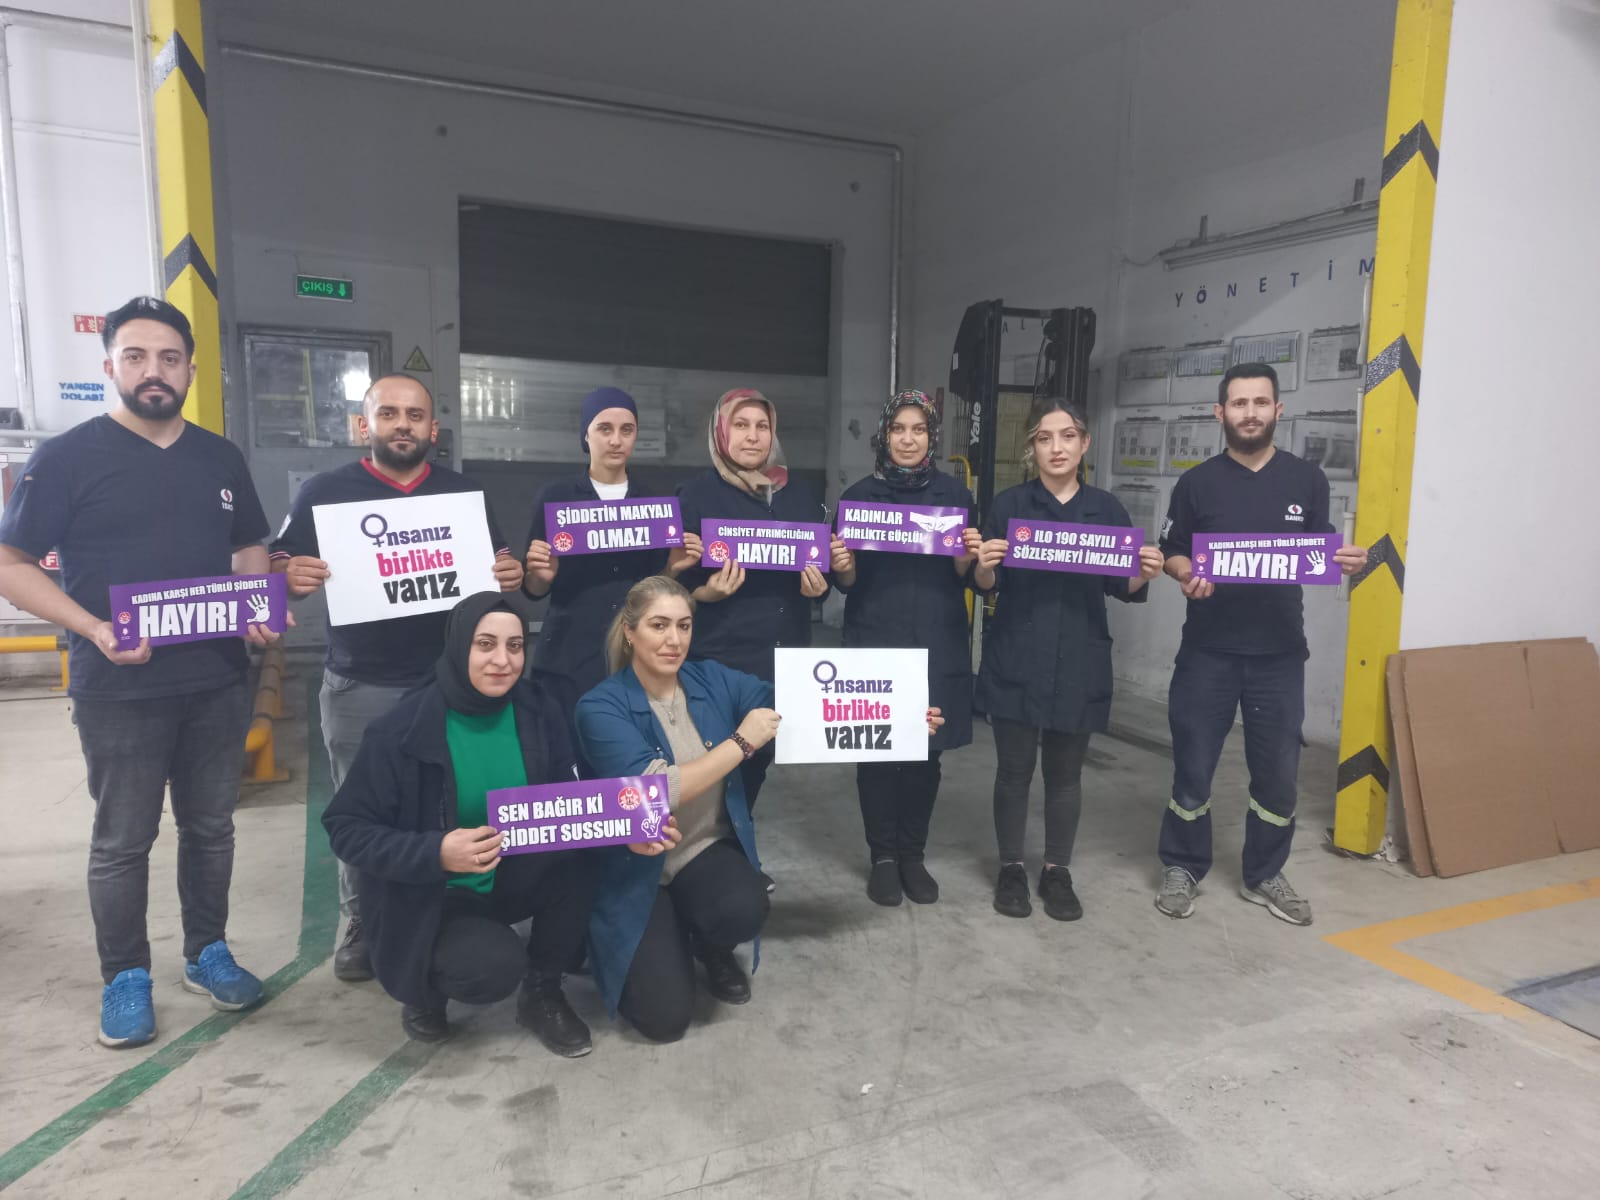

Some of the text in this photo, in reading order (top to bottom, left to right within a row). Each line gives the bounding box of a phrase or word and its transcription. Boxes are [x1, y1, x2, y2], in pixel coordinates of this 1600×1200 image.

[302, 281, 334, 294] ÇIKIŞ
[1175, 256, 1375, 307] YÖNETİM
[58, 382, 104, 391] YANGIN
[61, 393, 104, 401] DOLABI
[970, 401, 981, 446] Yale
[556, 504, 673, 528] ŞİDDETİN MAKYAJI
[845, 508, 902, 524] KADINLAR
[587, 526, 650, 550] OLMAZ!
[718, 526, 815, 540] CİNSİYET AYRIMCILIĞINA
[844, 526, 886, 540] BİRLİKTE
[1034, 530, 1053, 544] ILO
[1056, 532, 1078, 545] 190
[1080, 534, 1116, 548] SAYILI
[1236, 540, 1256, 550] KARŞI
[1258, 540, 1271, 548] HER
[1272, 538, 1295, 547] TÜRLÜ
[1296, 538, 1325, 548] ŞİDDETE
[376, 549, 454, 577] birlikte
[738, 542, 796, 565] HAYIR!
[1013, 544, 1133, 568] SÖZLEŞMEYİ İMZALA!
[1212, 551, 1299, 580] HAYIR!
[164, 588, 189, 600] KARŞI
[190, 586, 205, 596] HER
[206, 582, 233, 594] TÜRLÜ
[234, 579, 268, 593] ŞİDDETE
[383, 571, 460, 604] varız
[138, 601, 238, 638] HAYIR!
[822, 698, 890, 722] birlikte
[825, 724, 892, 750] varız
[498, 793, 604, 824] SEN BAĞIR Kİ
[501, 818, 632, 852] ŞİDDET SUSSUN!
